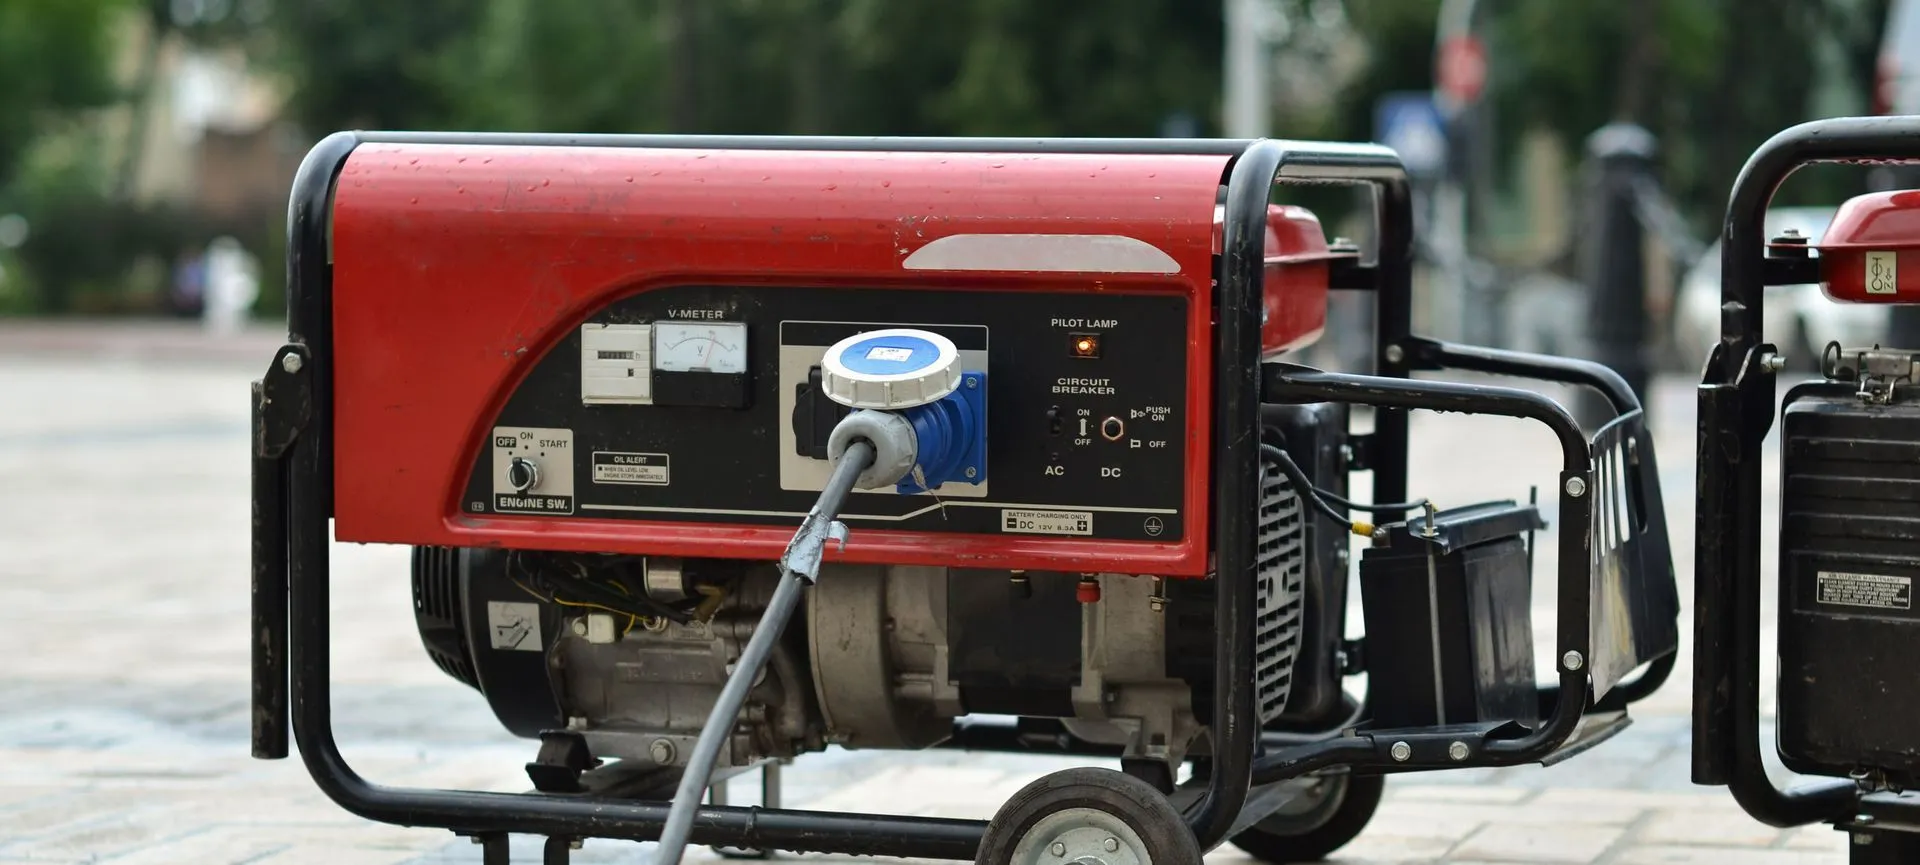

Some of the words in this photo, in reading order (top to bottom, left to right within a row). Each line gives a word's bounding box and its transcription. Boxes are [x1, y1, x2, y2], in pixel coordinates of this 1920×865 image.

[668, 309, 724, 319] V-METER
[1051, 318, 1084, 328] PILOT
[1086, 319, 1118, 328] LAMP
[1057, 377, 1111, 386] CIRCUIT
[1052, 385, 1116, 395] BREAKER
[1076, 408, 1090, 416] ON
[1145, 406, 1171, 414] PUSH
[1151, 413, 1165, 421] ON
[520, 431, 533, 440] ON
[497, 437, 516, 447] OFF
[539, 439, 568, 448] START
[1074, 438, 1092, 446] OFF
[1148, 440, 1167, 448] OFF
[626, 456, 647, 464] ALERT
[1045, 465, 1064, 475] AC
[1101, 467, 1121, 477] DC
[500, 497, 543, 508] ENGINE
[547, 499, 568, 509] SW.
[1019, 521, 1034, 529] DC
